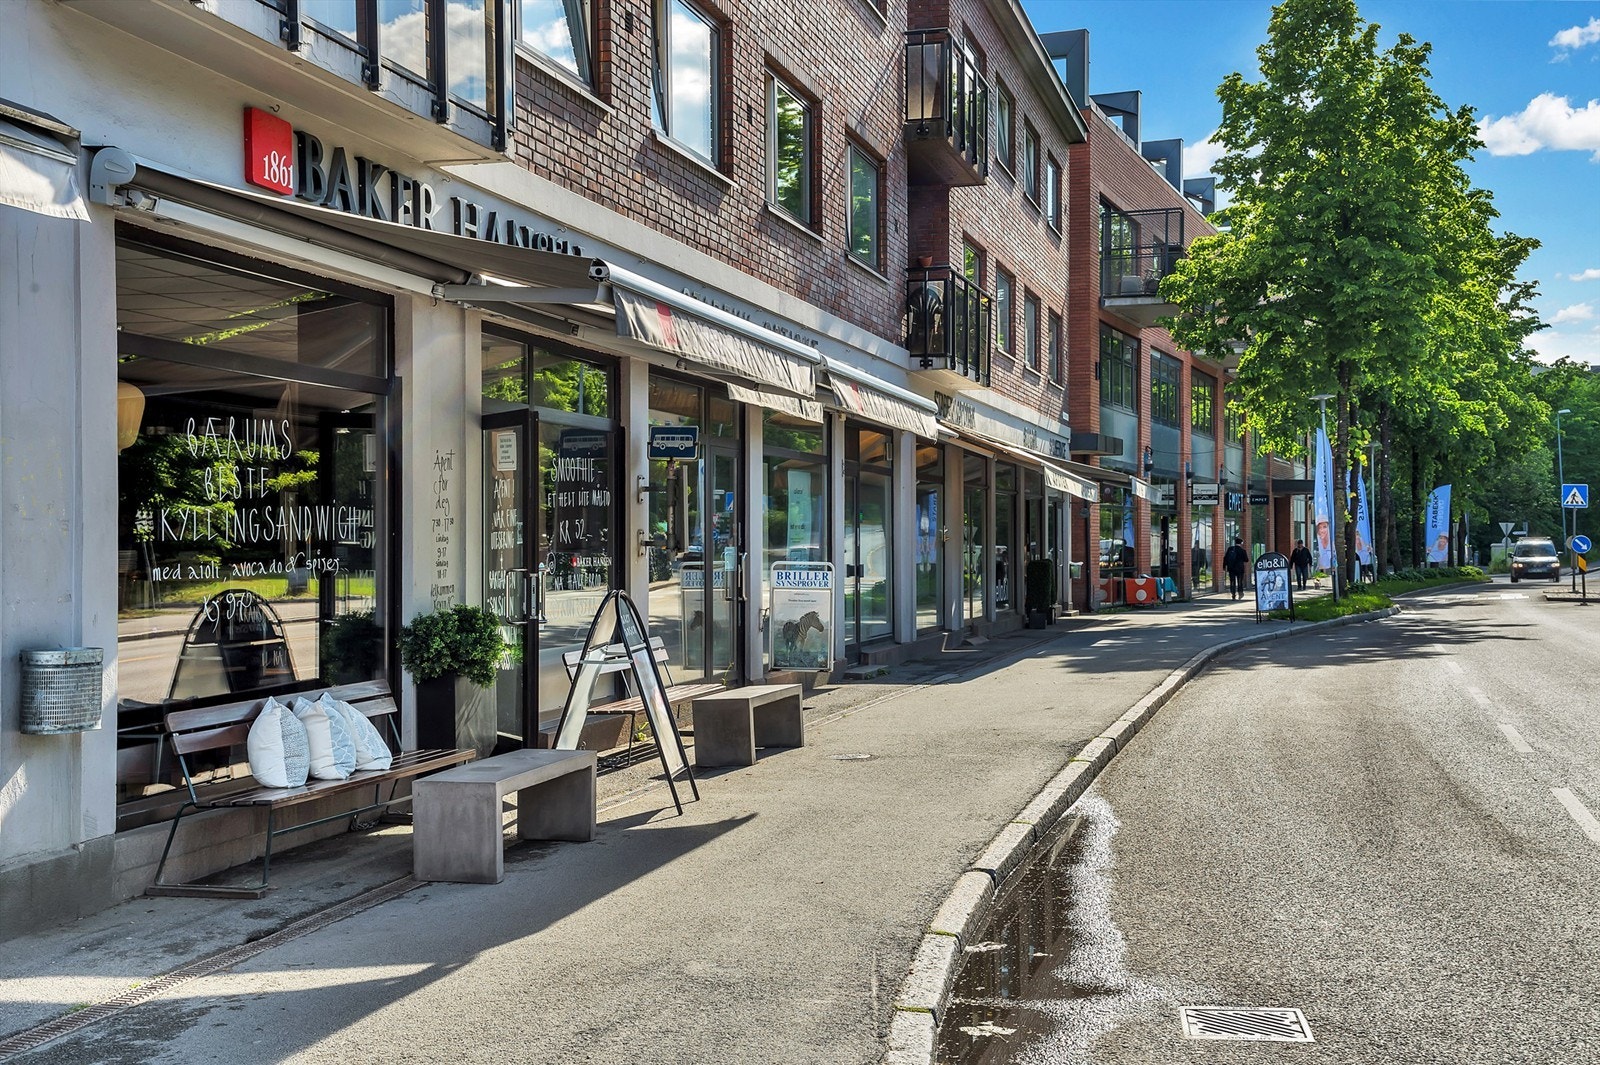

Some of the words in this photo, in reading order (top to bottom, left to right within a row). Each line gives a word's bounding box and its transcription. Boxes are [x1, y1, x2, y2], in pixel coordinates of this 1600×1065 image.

[262, 150, 293, 189] 1861
[294, 130, 439, 230] BAKER
[186, 416, 292, 460] BÆRUMS
[551, 452, 595, 482] SMOOTHIE
[204, 466, 270, 500] BESTE
[560, 520, 571, 544] KR
[153, 562, 181, 582] med
[232, 557, 283, 578] avocado
[776, 580, 829, 588] SYNSPRØVER
[777, 571, 829, 580] BRILLER
